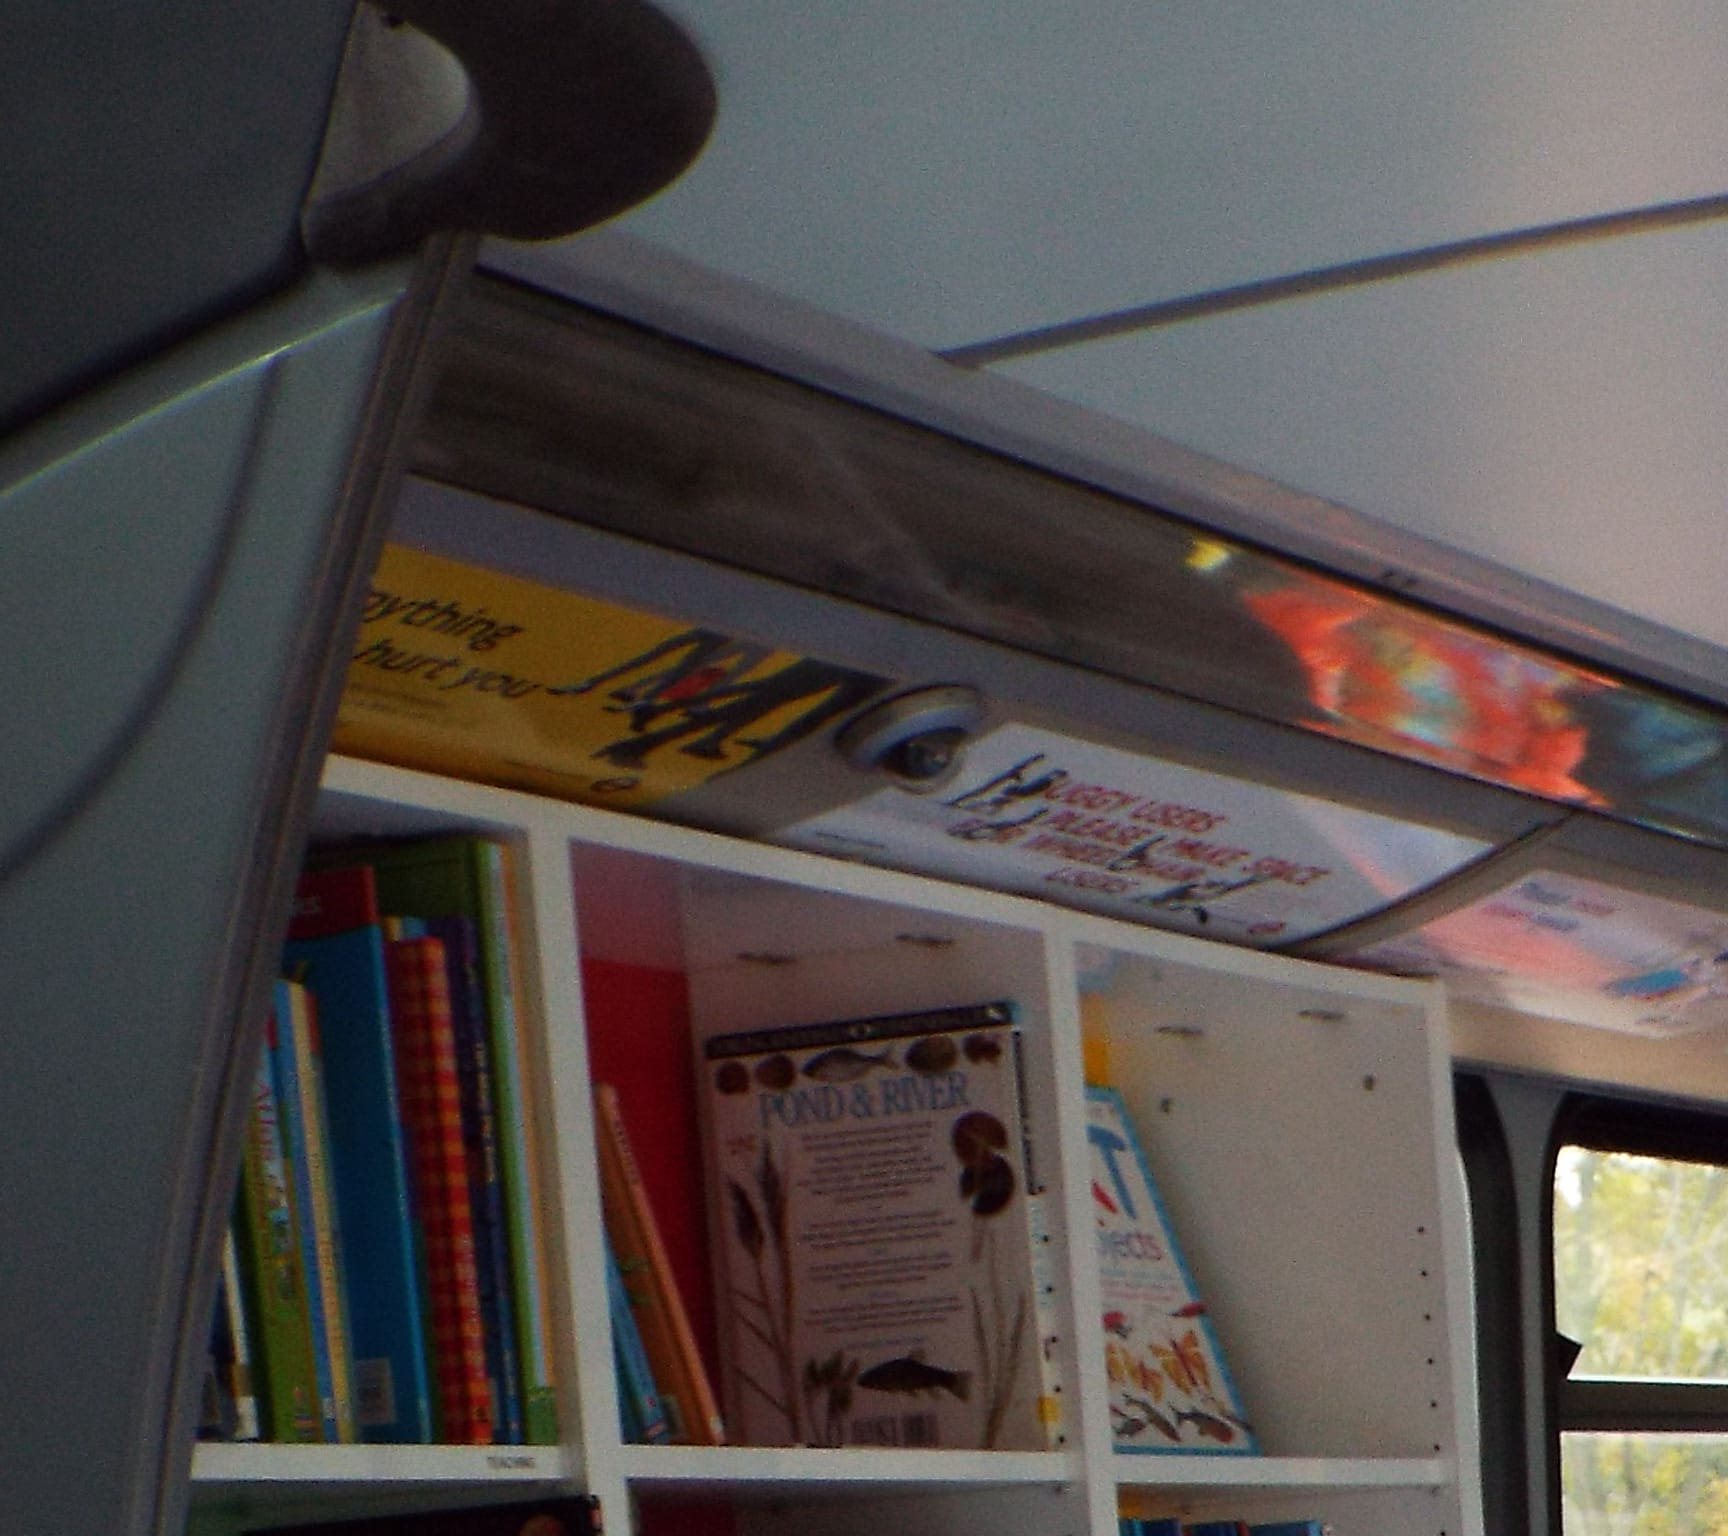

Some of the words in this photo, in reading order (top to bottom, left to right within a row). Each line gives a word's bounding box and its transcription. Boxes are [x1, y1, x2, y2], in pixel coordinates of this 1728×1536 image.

[354, 637, 459, 681] hurt
[439, 666, 541, 699] you
[757, 1085, 847, 1128] POND
[852, 1083, 880, 1117] &
[884, 1070, 972, 1114] RIVER
